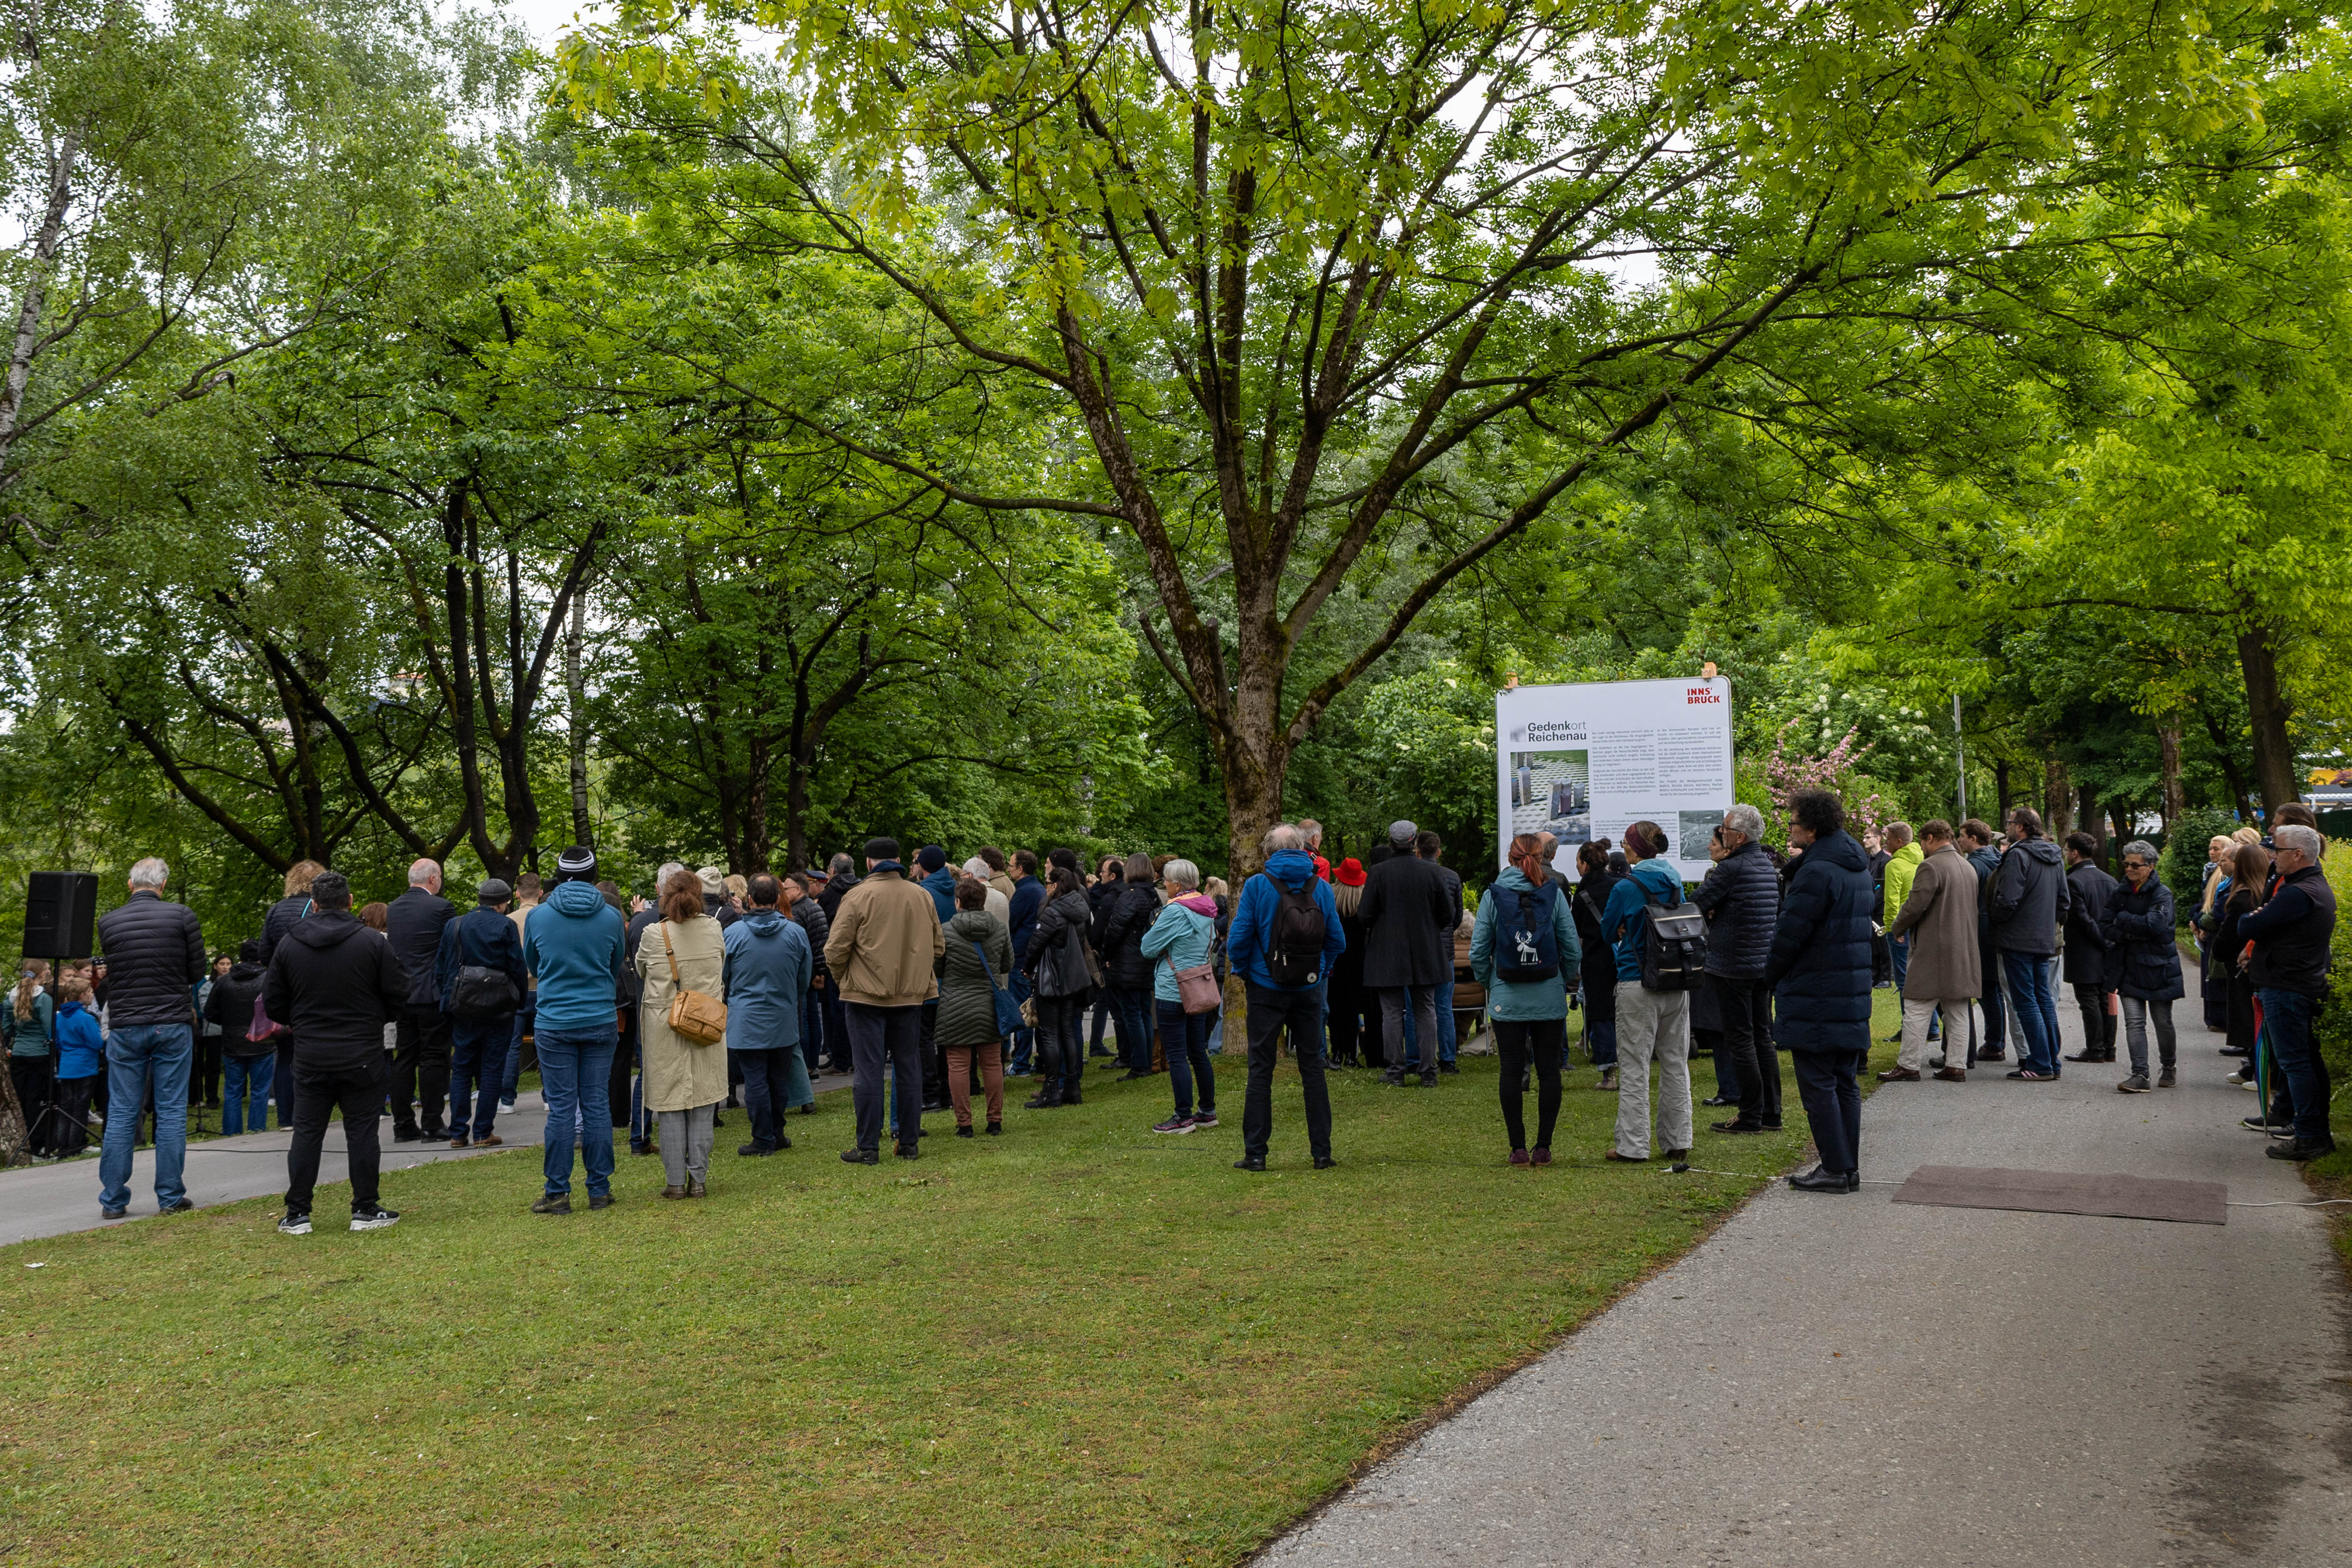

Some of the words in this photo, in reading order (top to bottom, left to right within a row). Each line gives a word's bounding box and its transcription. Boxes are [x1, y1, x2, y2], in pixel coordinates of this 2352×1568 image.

[1687, 695, 1720, 704] BRUCK
[1528, 721, 1586, 732] Gedenkort
[1528, 732, 1586, 742] Reichenau
